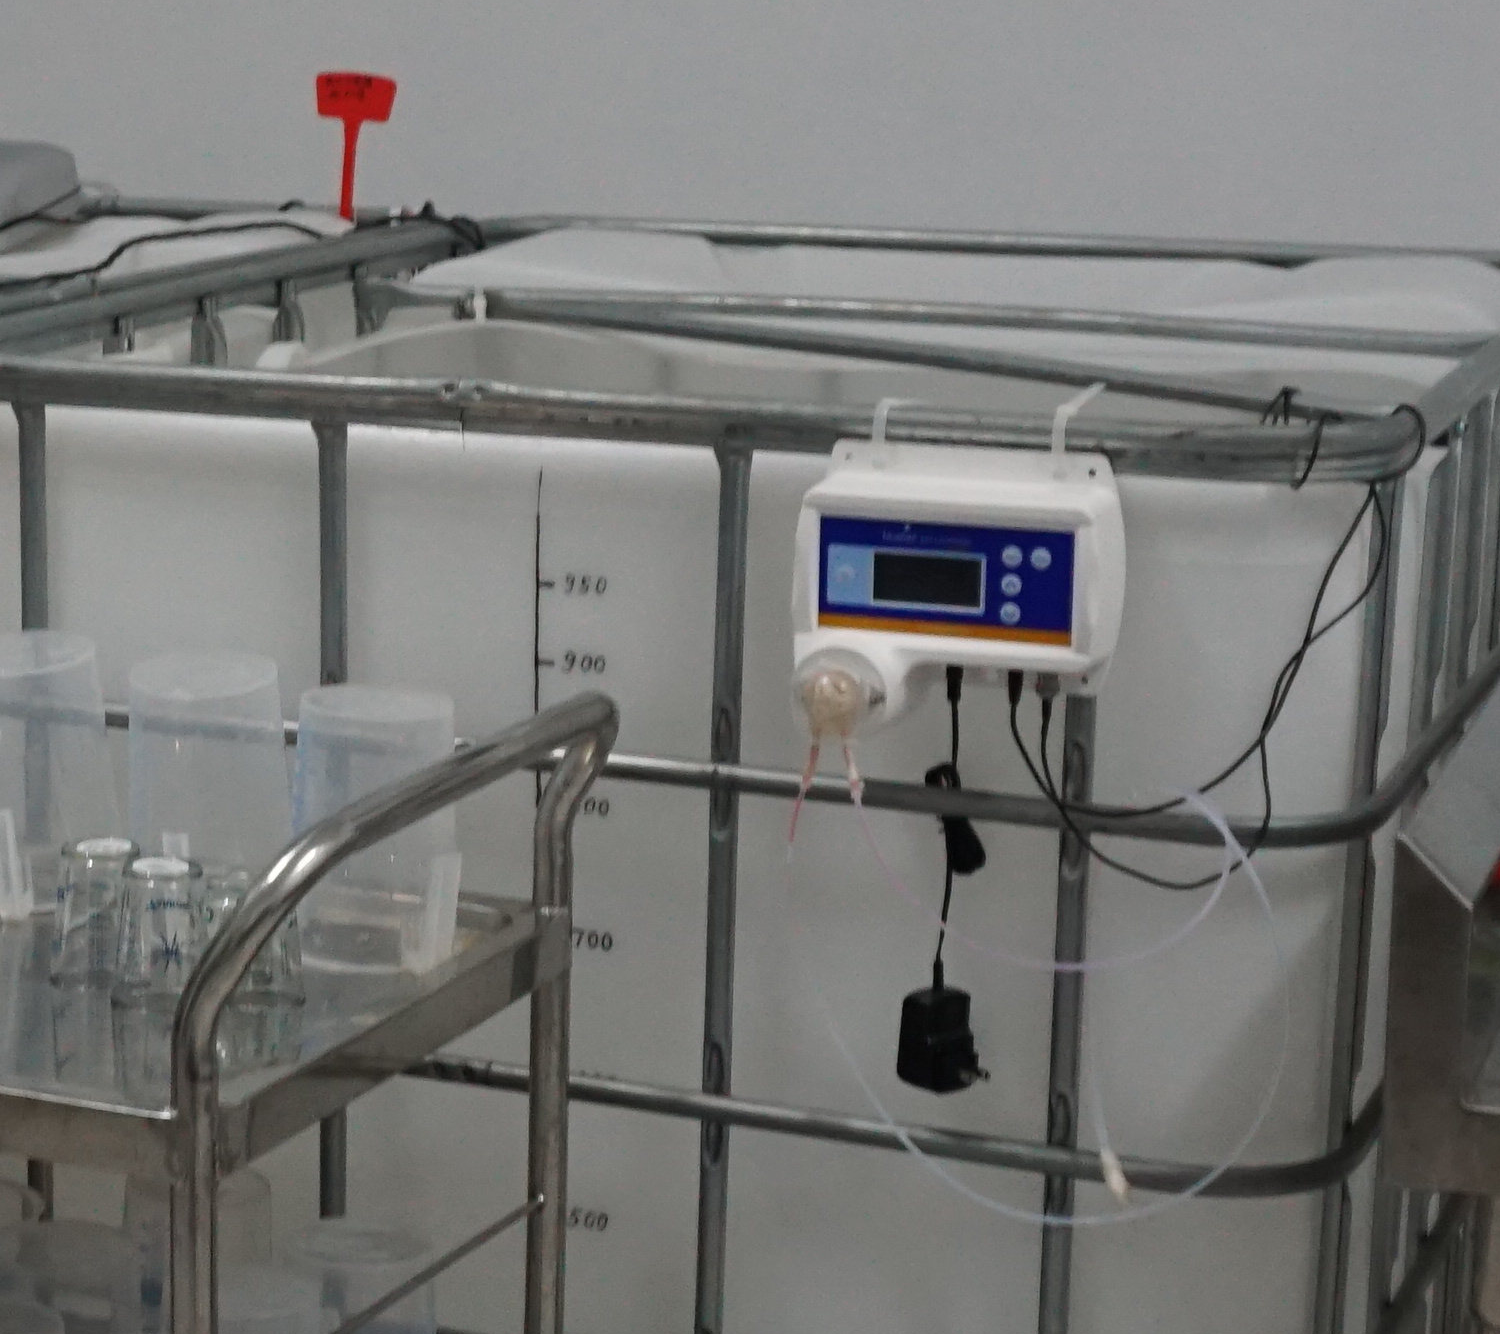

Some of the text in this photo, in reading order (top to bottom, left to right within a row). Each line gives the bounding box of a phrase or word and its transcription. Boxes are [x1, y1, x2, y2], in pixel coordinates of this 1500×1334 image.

[561, 649, 606, 675] 900
[584, 797, 610, 816] 00
[573, 927, 613, 952] 700
[570, 1207, 609, 1231] 500
